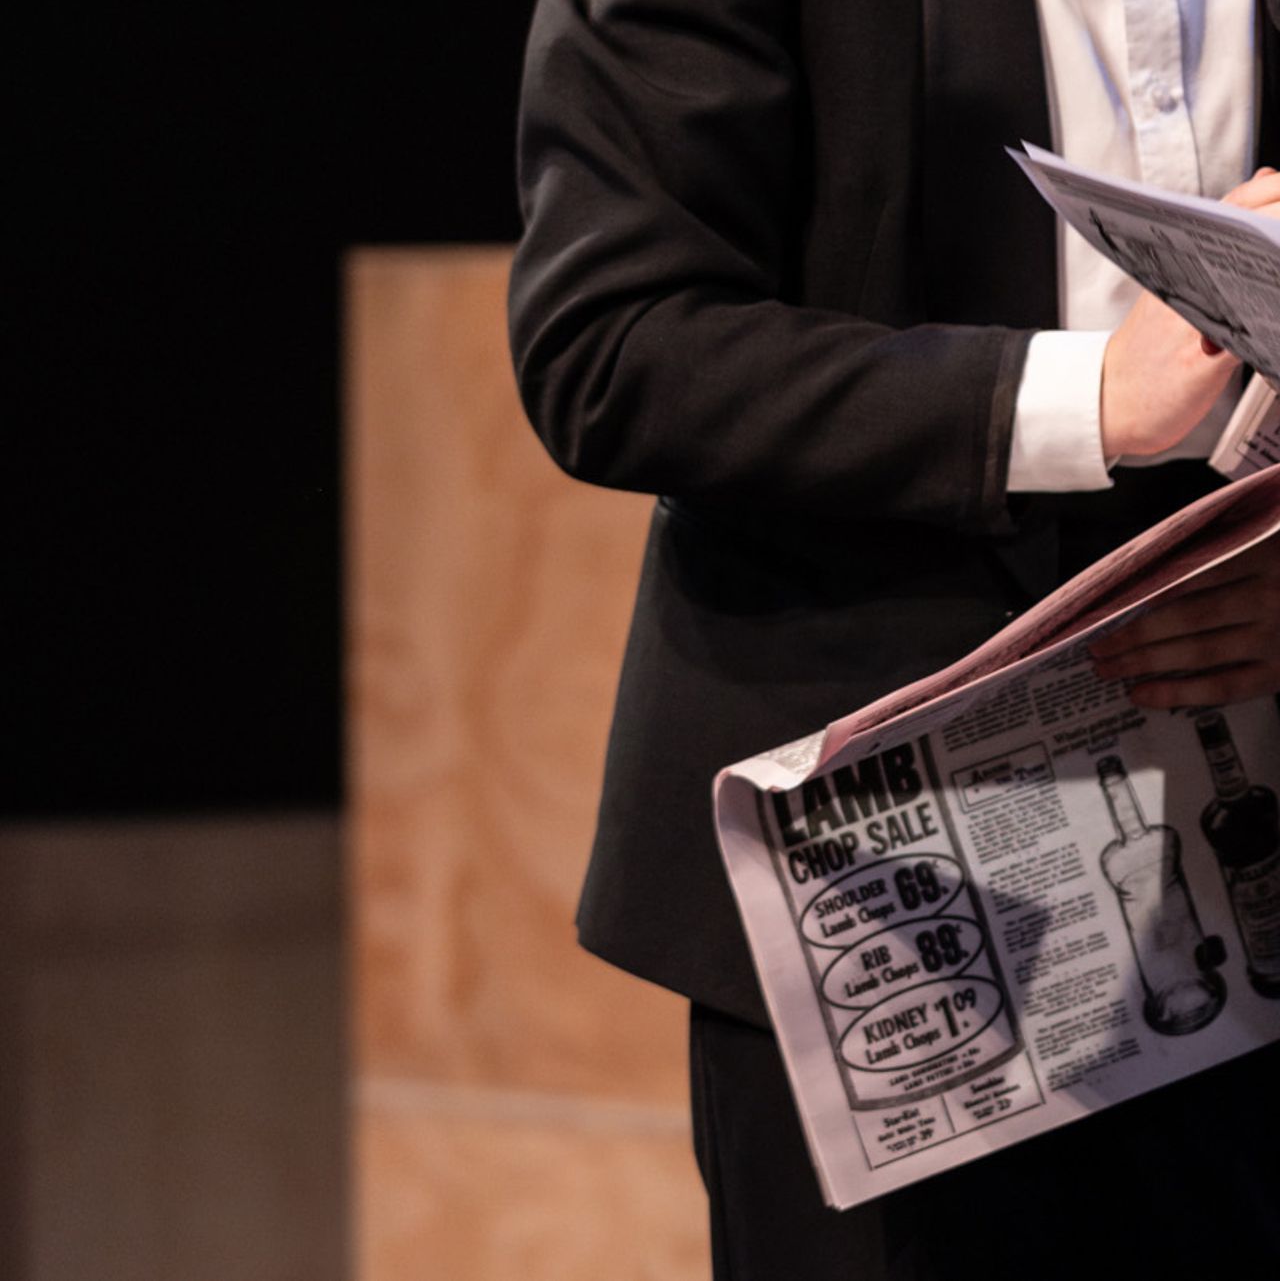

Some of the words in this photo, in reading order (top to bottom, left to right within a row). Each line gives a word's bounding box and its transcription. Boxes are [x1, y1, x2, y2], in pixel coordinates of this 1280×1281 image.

[770, 741, 923, 848] LAMB
[788, 830, 860, 885] CHOP
[866, 801, 940, 856] SALE
[814, 878, 888, 919] SHOULDER
[818, 912, 858, 939] Lamb
[858, 901, 898, 926] Chops
[860, 944, 892, 972] RIB
[843, 974, 881, 999] Lamb
[882, 962, 920, 984] Chops
[862, 1002, 929, 1045] KIDNEY
[864, 1041, 902, 1066] Lamb
[902, 1028, 941, 1051] Chops
